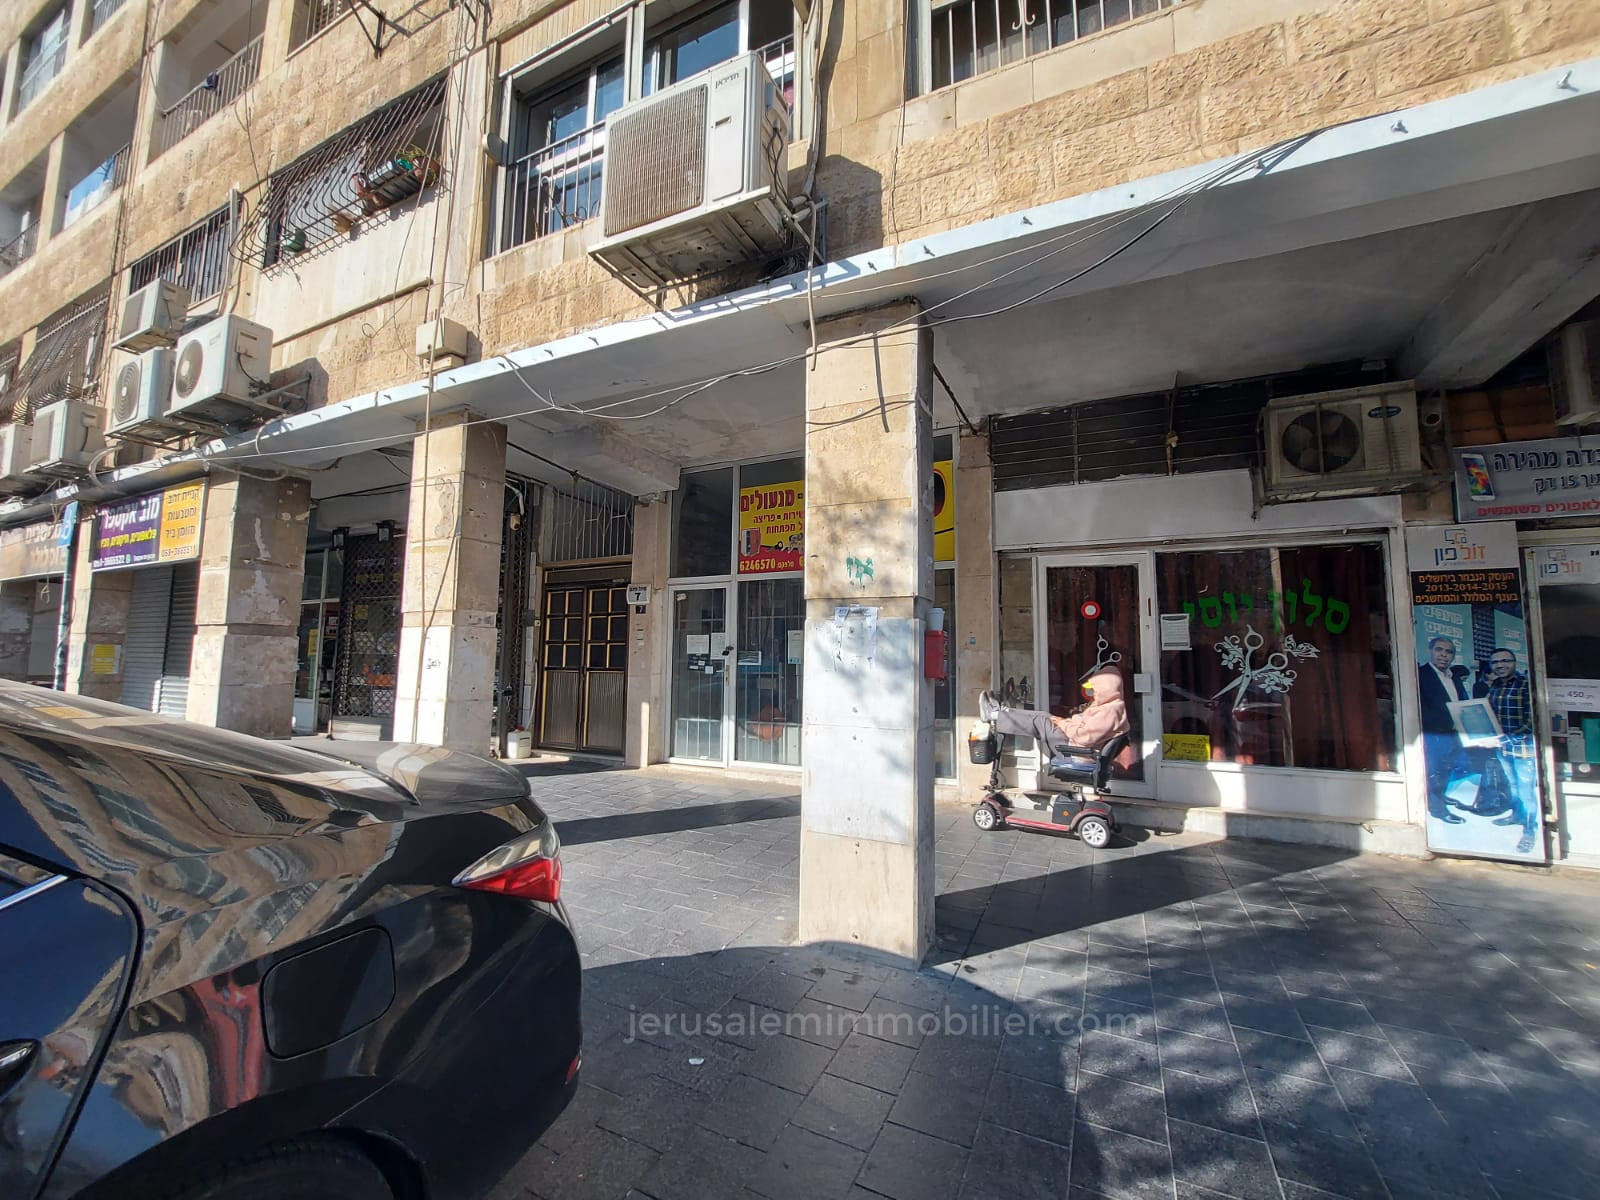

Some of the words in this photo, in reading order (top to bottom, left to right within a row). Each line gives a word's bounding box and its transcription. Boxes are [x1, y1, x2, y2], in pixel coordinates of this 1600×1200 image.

[1494, 451, 1558, 471] מהירה
[1561, 475, 1577, 489] 15
[741, 489, 795, 512] מנעולים
[1477, 503, 1541, 516] משומשים
[754, 514, 775, 524] פריצה
[767, 523, 796, 534] מפתחות
[1267, 578, 1350, 634] סלון
